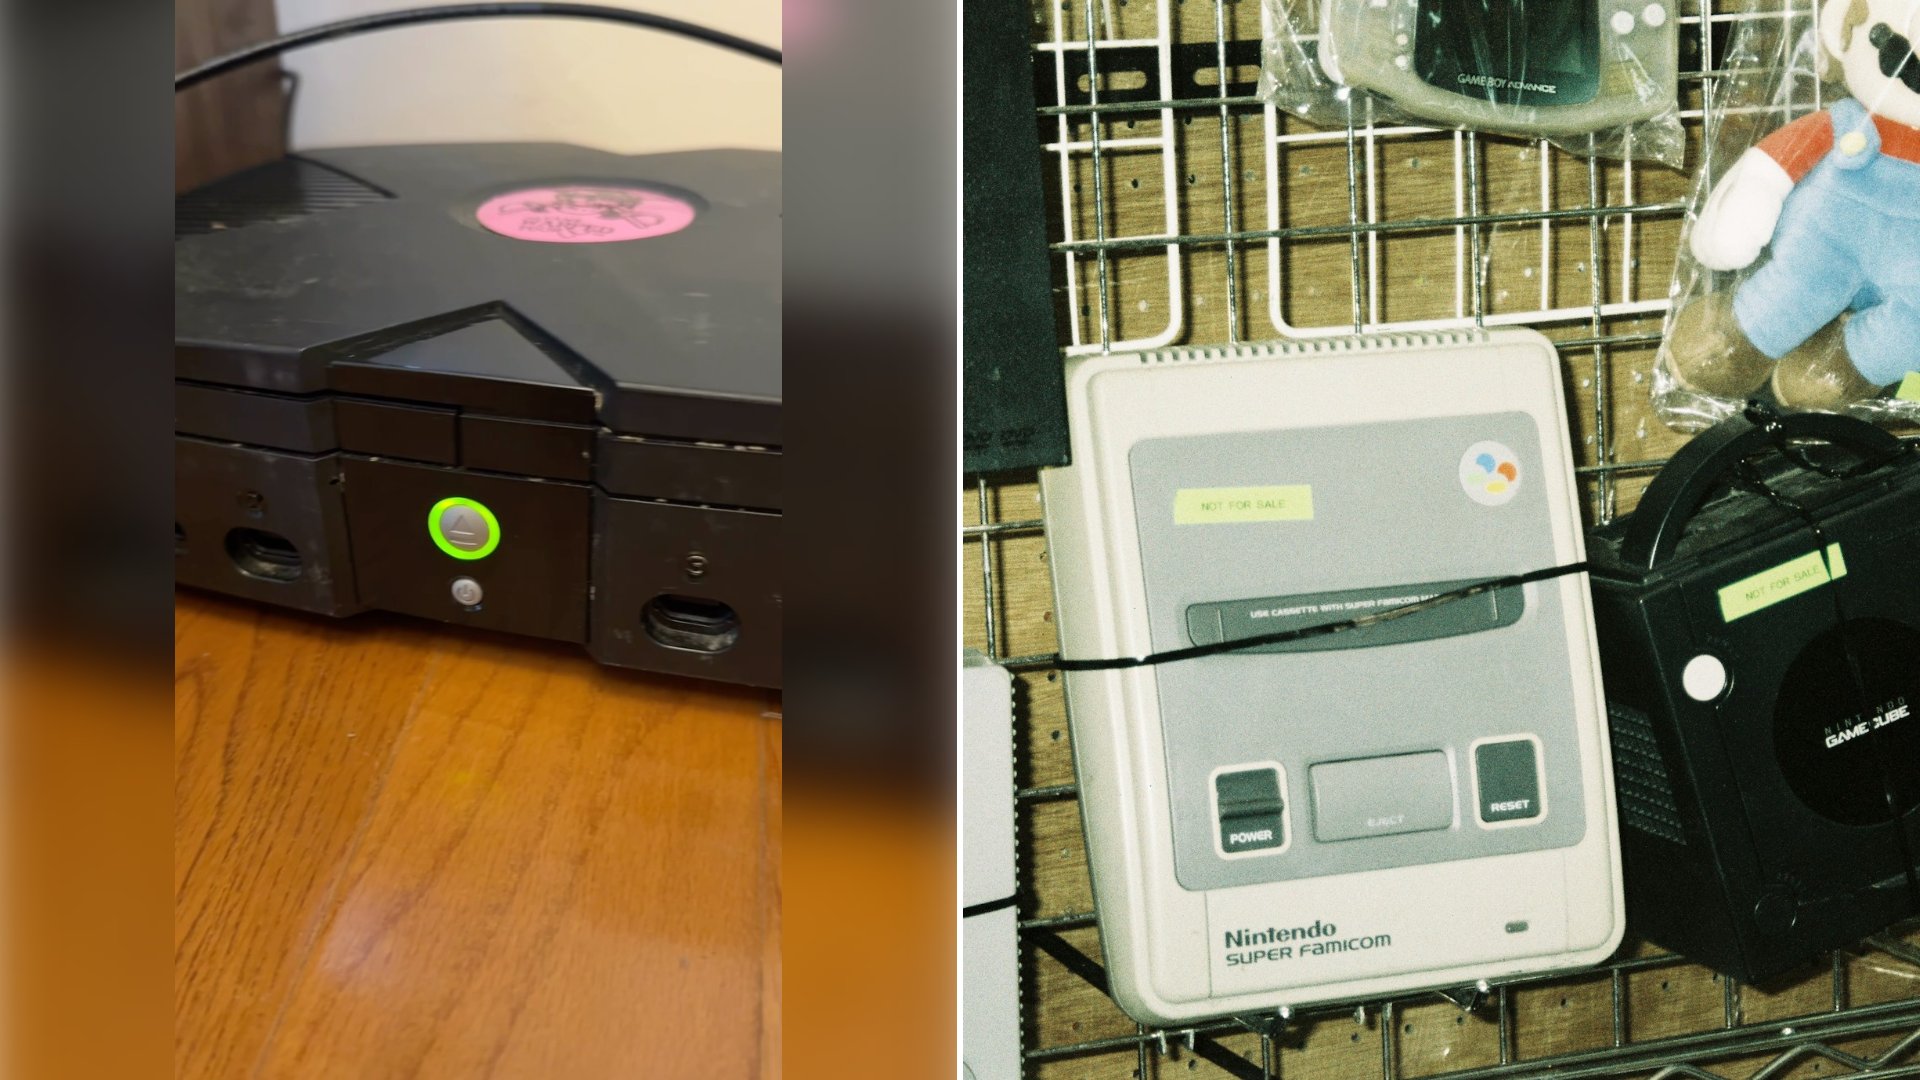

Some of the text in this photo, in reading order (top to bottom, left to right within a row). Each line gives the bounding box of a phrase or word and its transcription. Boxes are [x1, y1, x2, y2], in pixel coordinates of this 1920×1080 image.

[1507, 80, 1557, 94] ADVANCE
[1201, 499, 1286, 511] NOT FOR SALE
[1745, 564, 1820, 601] NOT FOR SALE
[1250, 609, 1269, 619] USE
[1271, 605, 1317, 617] CASSETTE
[1320, 603, 1343, 613] WITH
[1344, 600, 1375, 610] SUPER
[1824, 696, 1905, 736] NINTNDO
[1491, 800, 1530, 813] RESET
[1230, 829, 1273, 845] POWER
[1225, 920, 1337, 949] Nintendo
[1226, 946, 1293, 967] SUPER
